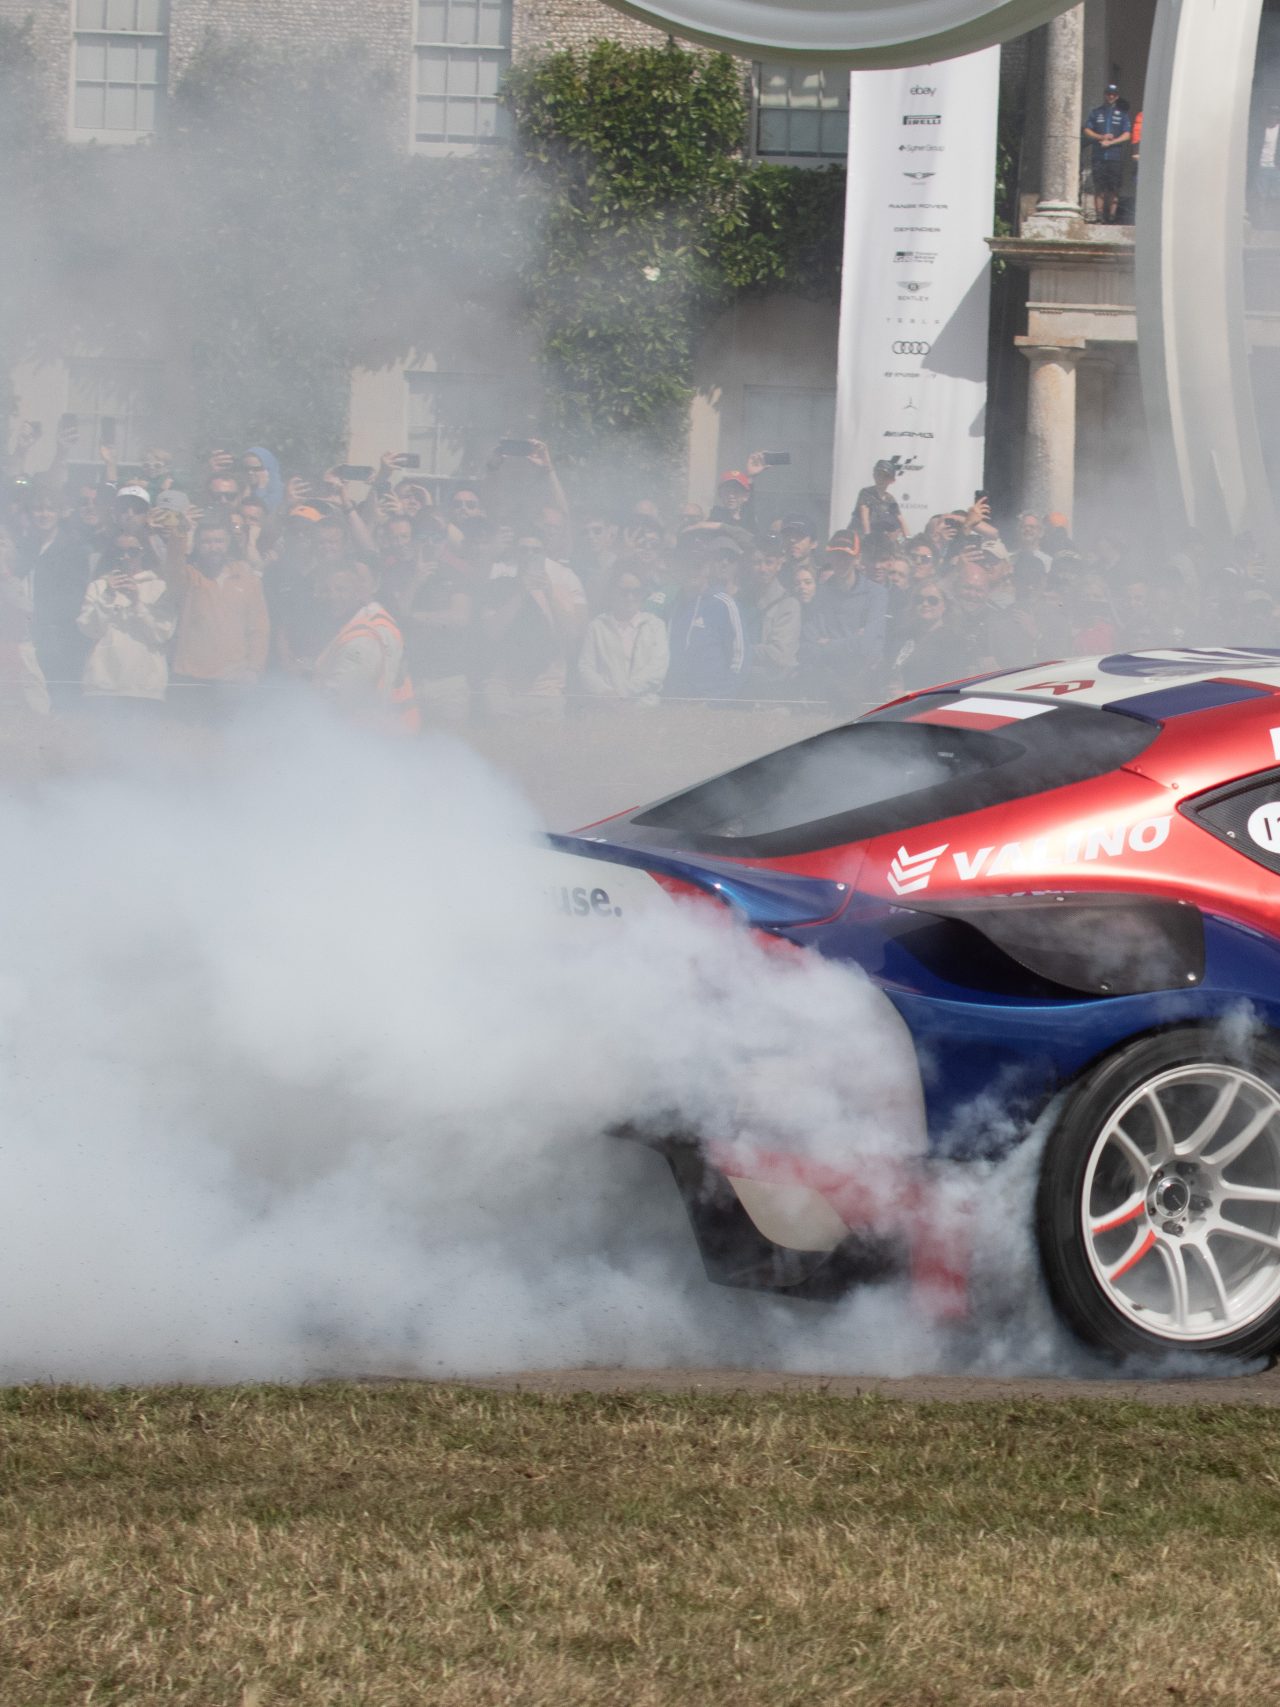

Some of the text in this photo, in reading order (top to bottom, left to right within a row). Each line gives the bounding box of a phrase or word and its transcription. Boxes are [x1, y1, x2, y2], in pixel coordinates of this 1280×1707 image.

[909, 85, 937, 97] ebay
[902, 115, 942, 125] PIRELLI
[952, 815, 1175, 881] VALINO
